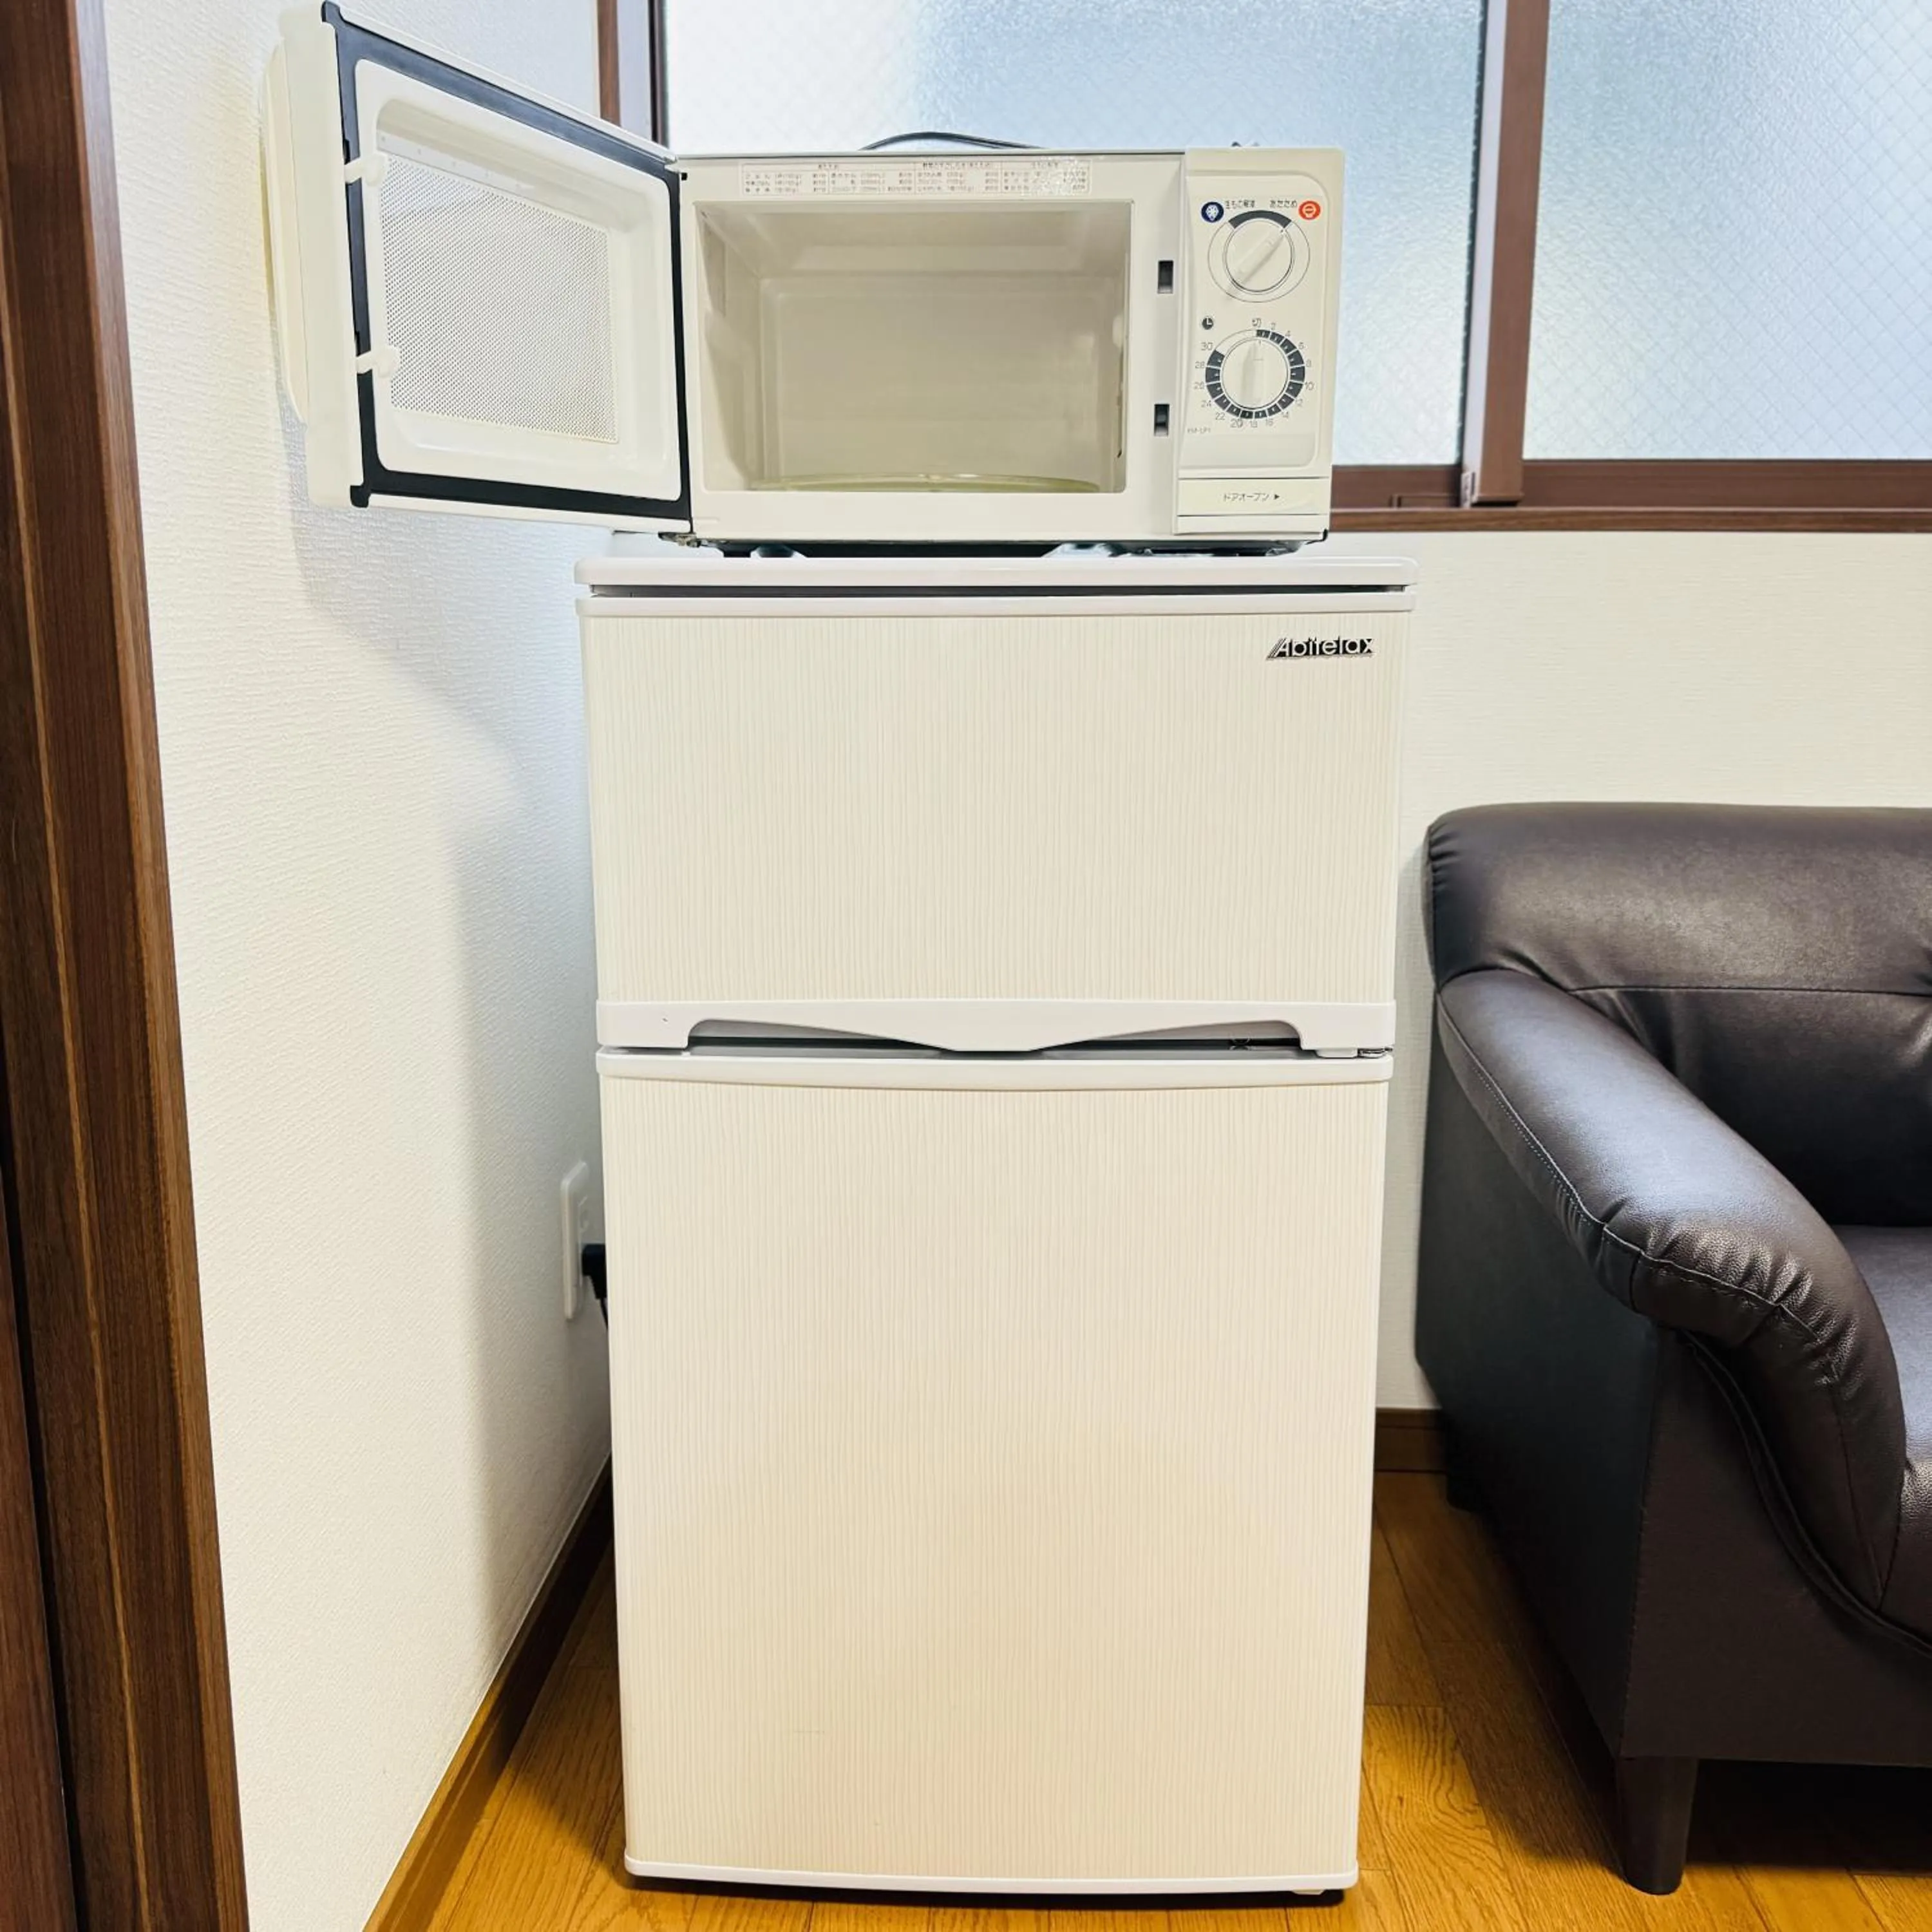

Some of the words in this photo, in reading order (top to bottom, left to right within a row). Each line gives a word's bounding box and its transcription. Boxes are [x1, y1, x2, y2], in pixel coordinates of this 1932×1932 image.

[1223, 493, 1270, 502] ドアオープン
[1267, 636, 1373, 659] Abitelax
